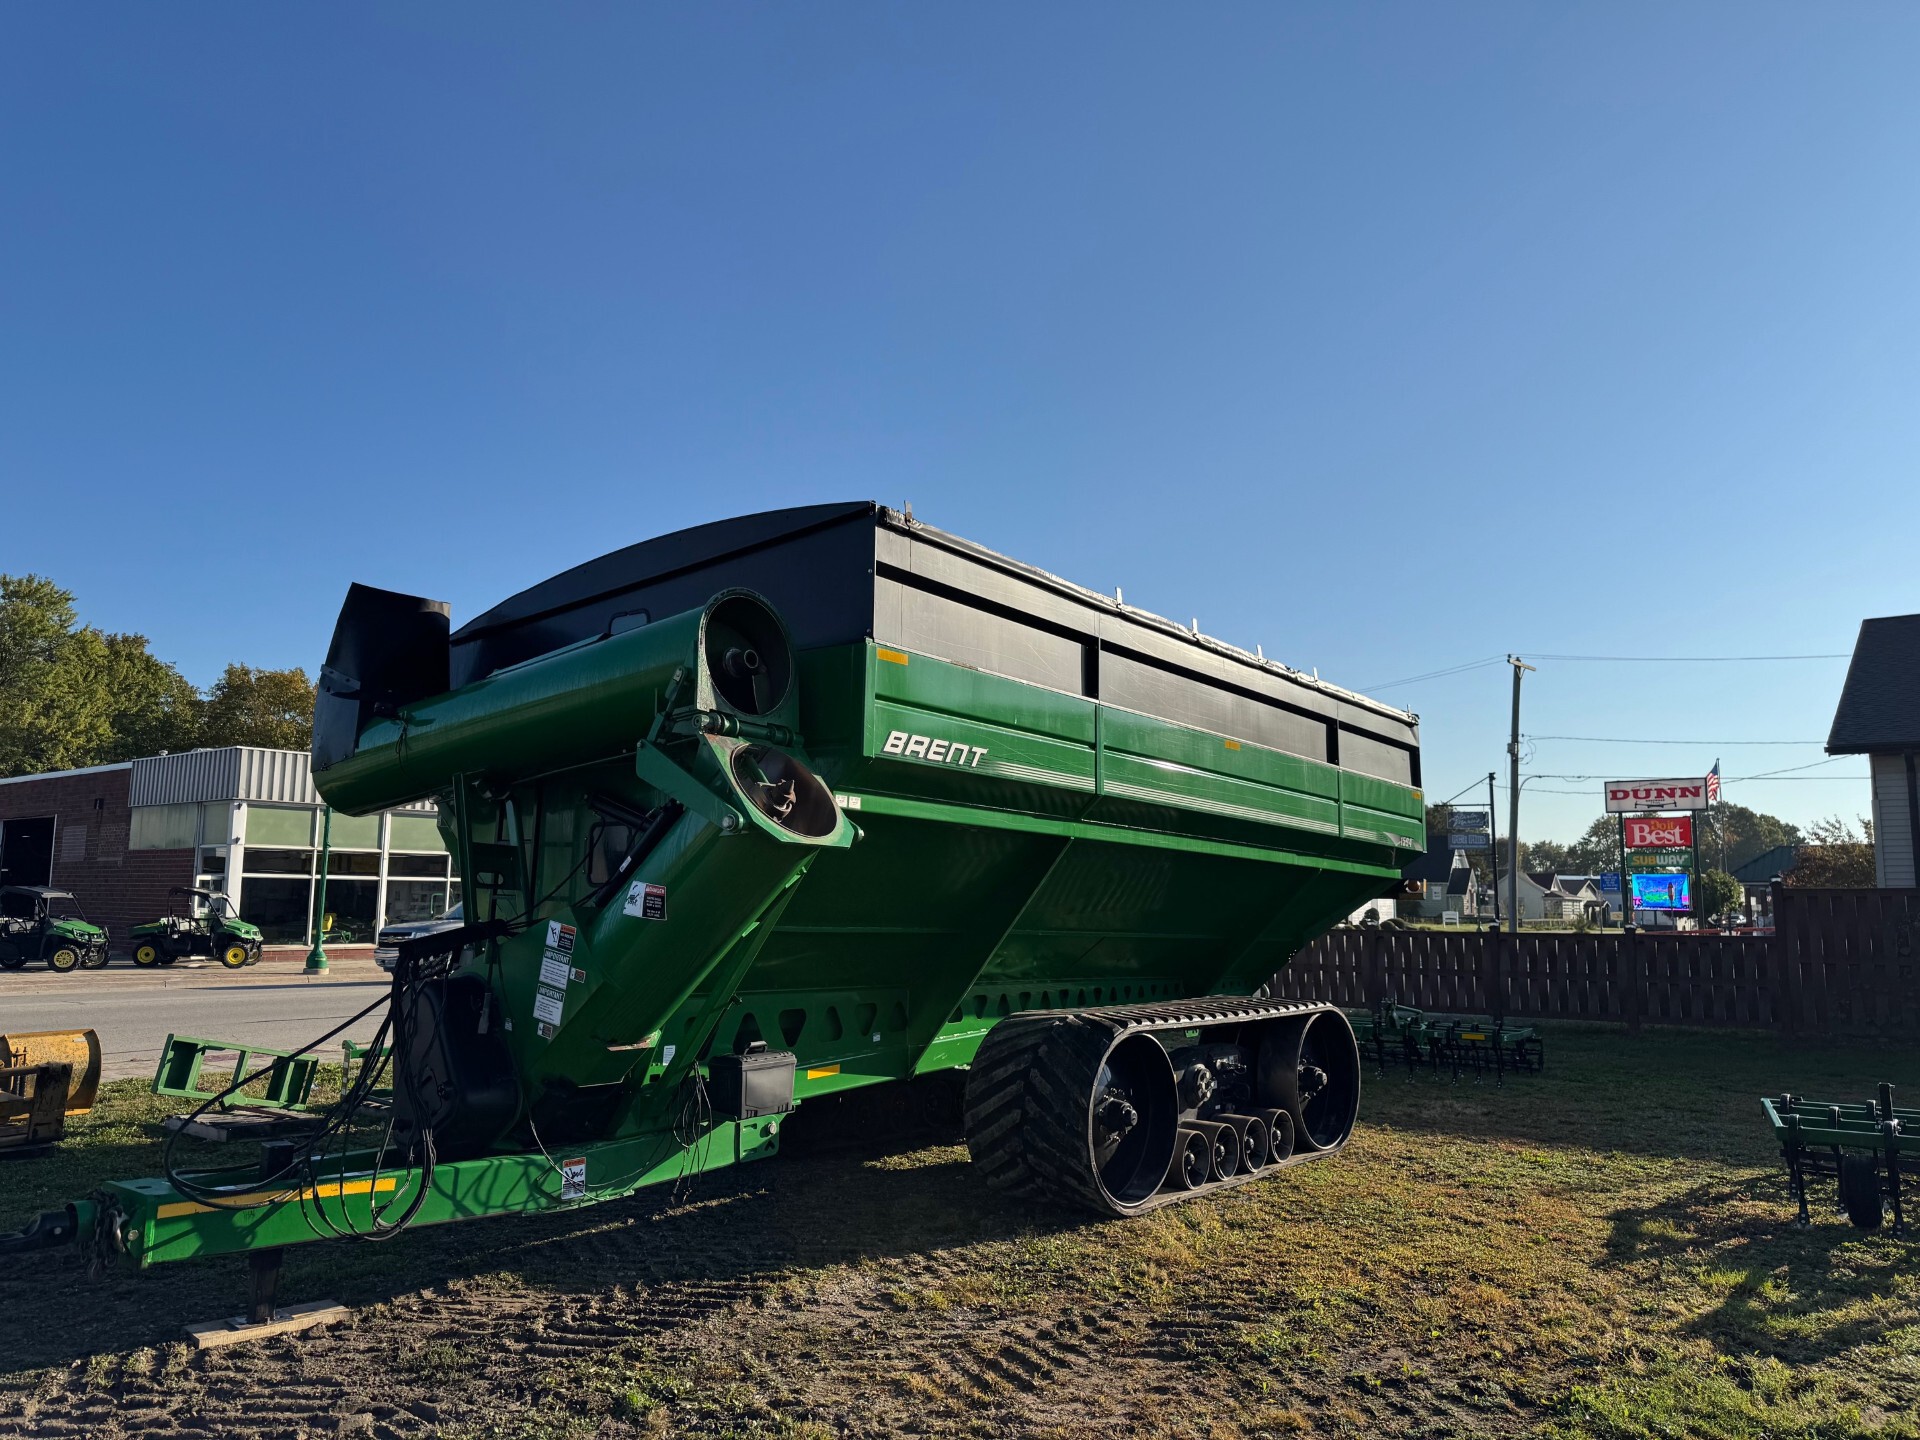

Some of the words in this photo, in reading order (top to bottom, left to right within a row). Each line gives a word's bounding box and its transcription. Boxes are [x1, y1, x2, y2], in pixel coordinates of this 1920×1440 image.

[883, 730, 989, 768] BRENT
[1609, 786, 1702, 801] DUNN
[1631, 823, 1685, 845] Best
[1631, 854, 1688, 866] SUBWAY
